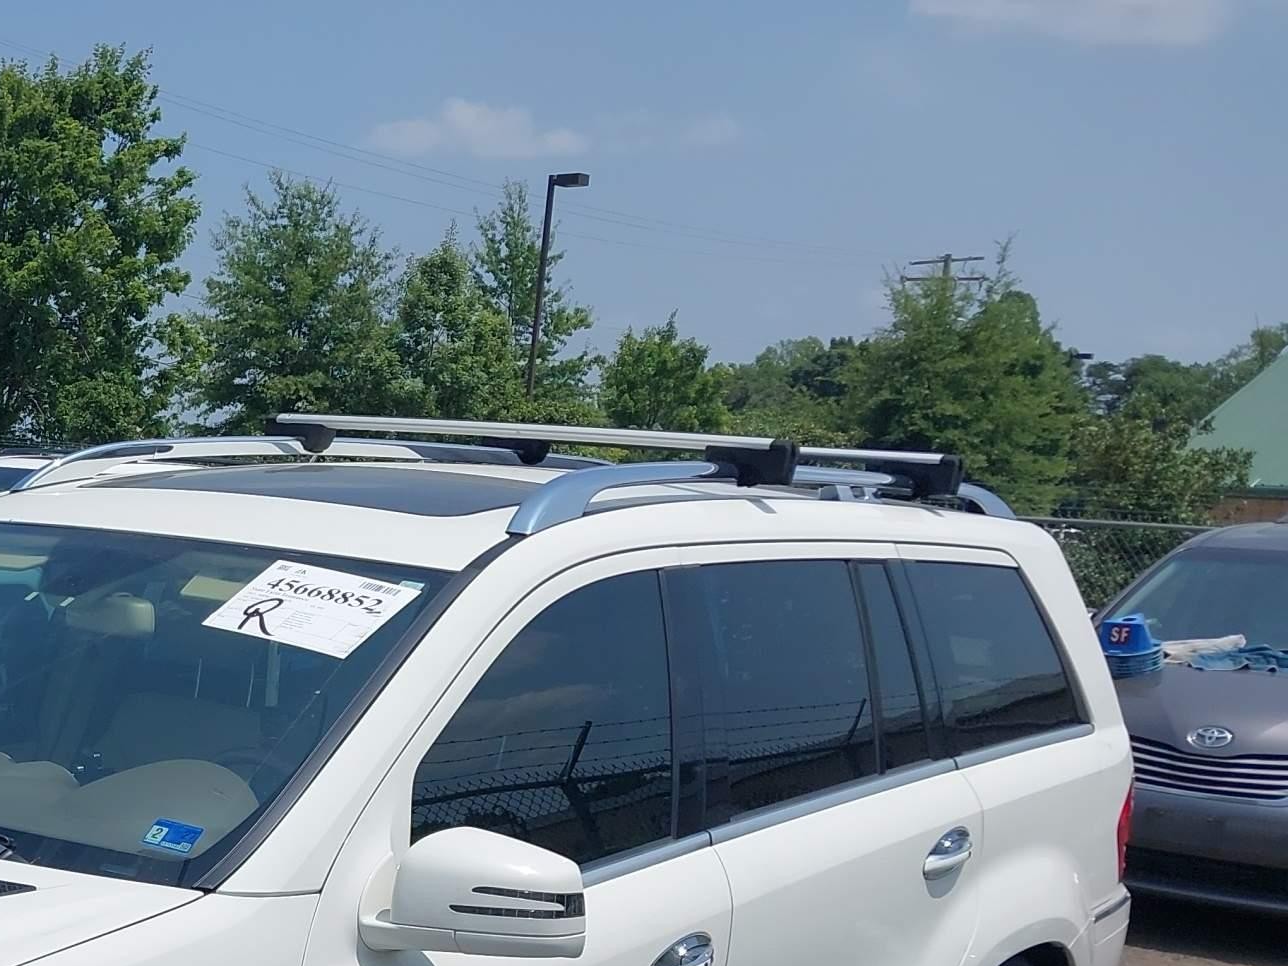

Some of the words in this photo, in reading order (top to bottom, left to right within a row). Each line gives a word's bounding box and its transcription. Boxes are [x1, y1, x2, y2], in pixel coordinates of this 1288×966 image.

[267, 577, 383, 614] 45668852
[237, 597, 283, 637] R
[1110, 626, 1130, 642] SF
